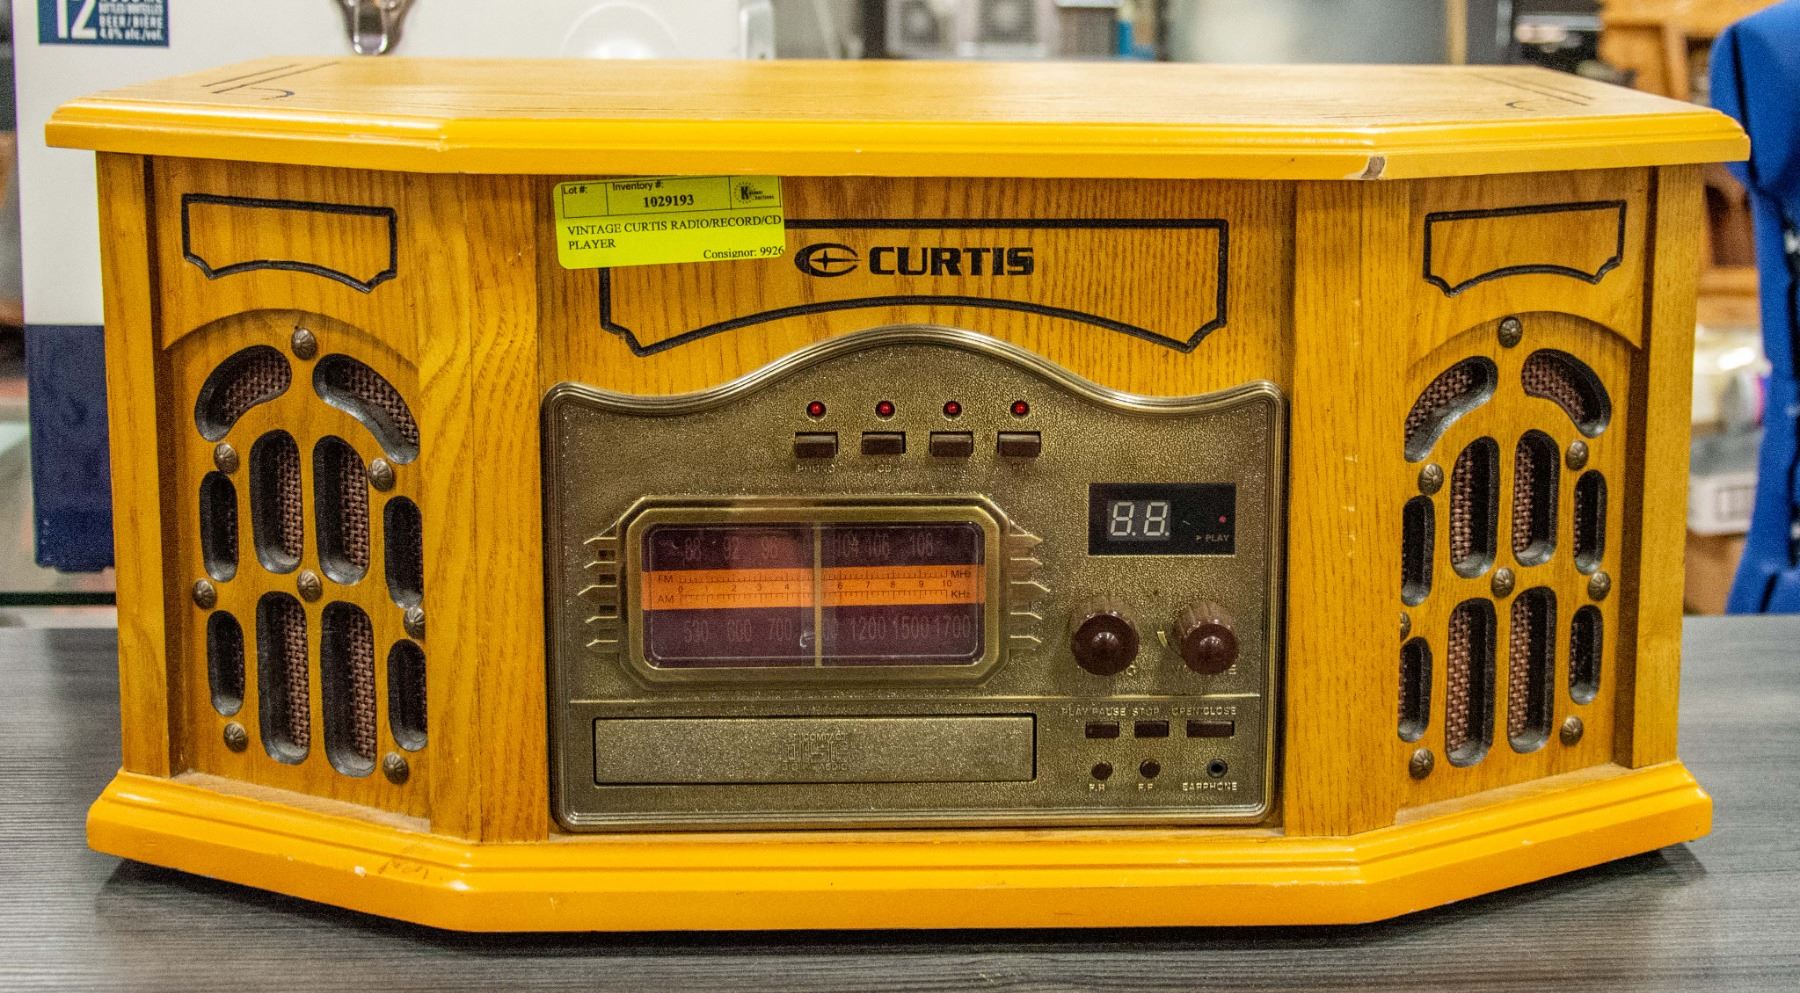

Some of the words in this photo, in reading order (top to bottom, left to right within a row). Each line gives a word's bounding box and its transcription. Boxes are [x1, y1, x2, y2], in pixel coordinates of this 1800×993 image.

[57, 0, 97, 39] 12
[562, 186, 578, 195] Lot
[612, 181, 653, 192] Inventory
[655, 180, 664, 190] #:
[643, 194, 695, 208] 1029193
[567, 223, 622, 236] VINTAGE
[624, 219, 668, 232] CURTIS
[671, 215, 782, 231] RADIO/RECORD/CD
[568, 238, 616, 250] PLAYER
[703, 248, 757, 260] Consignor:
[760, 245, 785, 257] 9926
[869, 246, 1035, 276] CURTIS
[1205, 534, 1230, 542] PLAY
[657, 575, 673, 583] FM
[657, 595, 675, 604] AM
